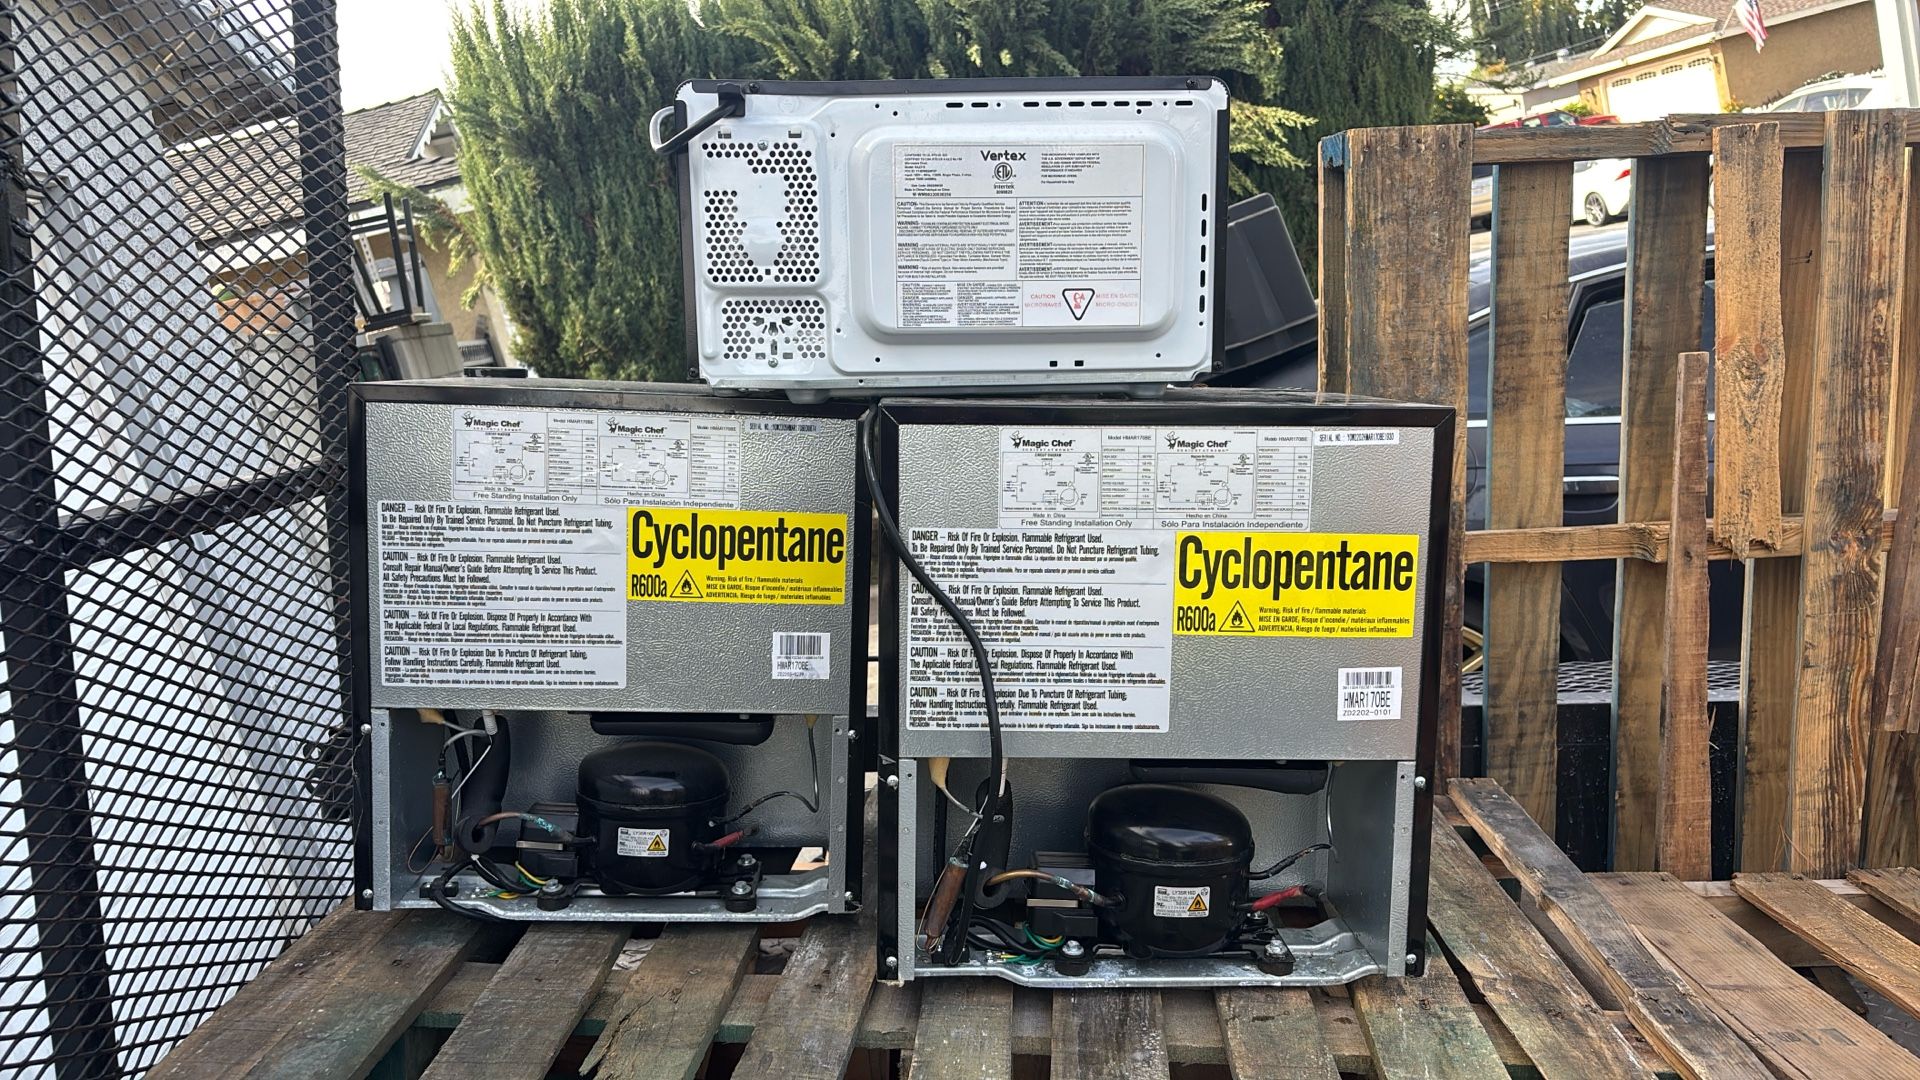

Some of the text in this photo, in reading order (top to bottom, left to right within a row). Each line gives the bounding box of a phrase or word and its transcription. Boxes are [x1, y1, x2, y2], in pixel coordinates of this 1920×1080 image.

[980, 150, 1026, 161] Vertex
[474, 420, 499, 428] Magic
[618, 425, 642, 434] Magic
[1022, 440, 1049, 448] Magic
[1177, 440, 1228, 449] Magic Chef
[683, 501, 733, 509] Independiente
[1040, 520, 1072, 528] Standing
[1114, 520, 1132, 528] Only
[1246, 522, 1303, 530] Independiente
[632, 510, 844, 570] Cyclopentane
[912, 530, 1104, 545] DANGER Risk Of Fire Or Explosion. Flammable Refrigerant Used.
[912, 544, 917, 552] To
[920, 544, 927, 552] Be
[929, 544, 954, 554] Repaired
[956, 544, 968, 554] Only
[970, 544, 978, 555] By
[980, 544, 1000, 553] Trained
[1002, 544, 1023, 553] Service
[1025, 545, 1053, 554] Personnel.
[1056, 545, 1064, 554] Do
[1066, 545, 1076, 554] Not
[1078, 545, 1104, 554] Puncture
[1106, 545, 1137, 556] Refrigerant
[382, 552, 562, 566] CAUTION Risk Of Fire Or Explosion. Flammable Refrigerant Used.
[382, 563, 402, 572] Consult
[404, 563, 421, 574] Repair
[466, 564, 482, 573] Guide
[483, 564, 501, 573] Before
[502, 565, 532, 576] Attempting
[534, 565, 539, 574] To
[541, 565, 561, 574] Service
[562, 566, 573, 574] This
[575, 566, 598, 575] Product.
[1178, 535, 1413, 600] Cyclopentane
[631, 574, 667, 597] R600a
[383, 610, 592, 623] CAUTION Risk Of Fire Or Explosion. Dispose Of Properly In Accordance With
[1177, 606, 1215, 632] R600a
[384, 621, 576, 634] The Applicable Federal Or Local Regulations. Flammable Refrigerant Used.
[384, 657, 560, 670] Follow Handling Instructions Carefully. Flammable Refrigerant Used.
[1344, 691, 1391, 708] HMAR170BE
